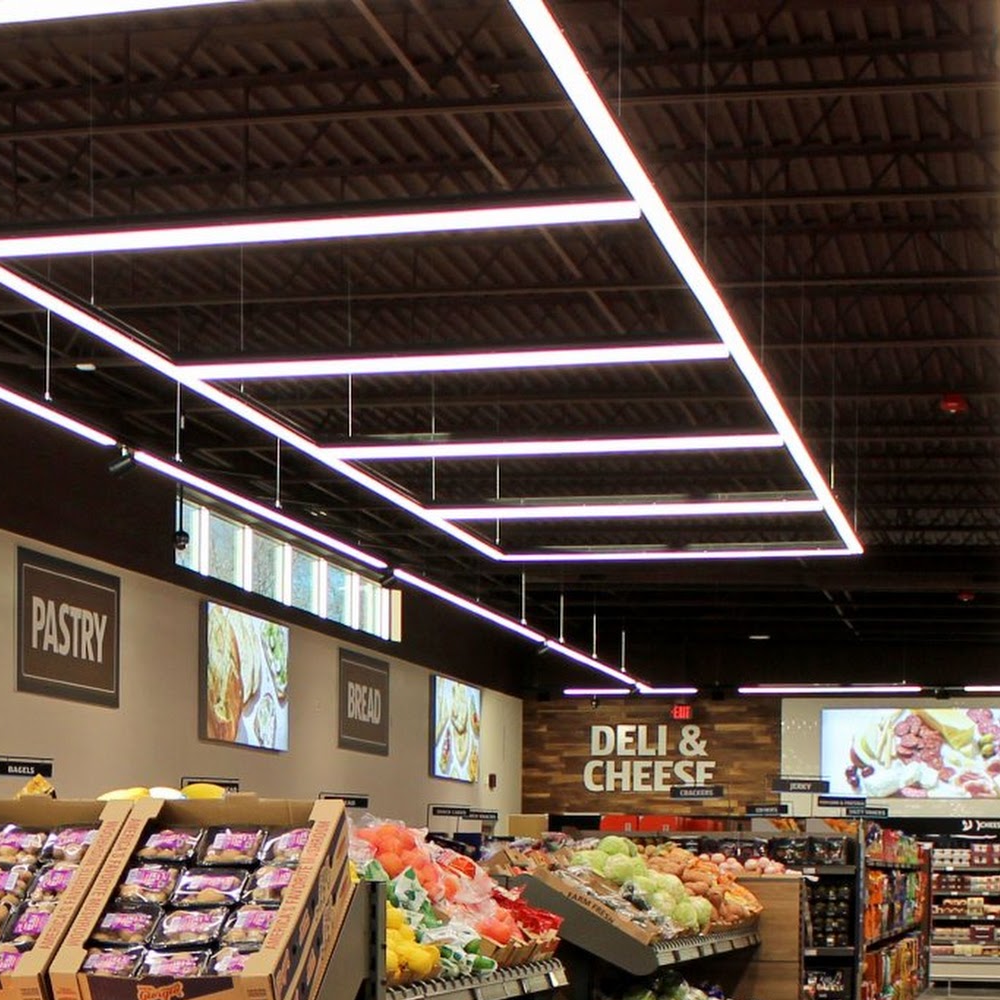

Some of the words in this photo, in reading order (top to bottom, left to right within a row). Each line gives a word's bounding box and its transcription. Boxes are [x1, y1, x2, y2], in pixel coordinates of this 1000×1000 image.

[31, 596, 107, 663] PASTRY
[347, 681, 381, 725] BREAD
[673, 705, 691, 719] EXIT
[591, 725, 668, 756] DELI
[678, 724, 708, 756] &
[7, 765, 35, 775] BAGELS
[583, 760, 716, 791] CHEESE
